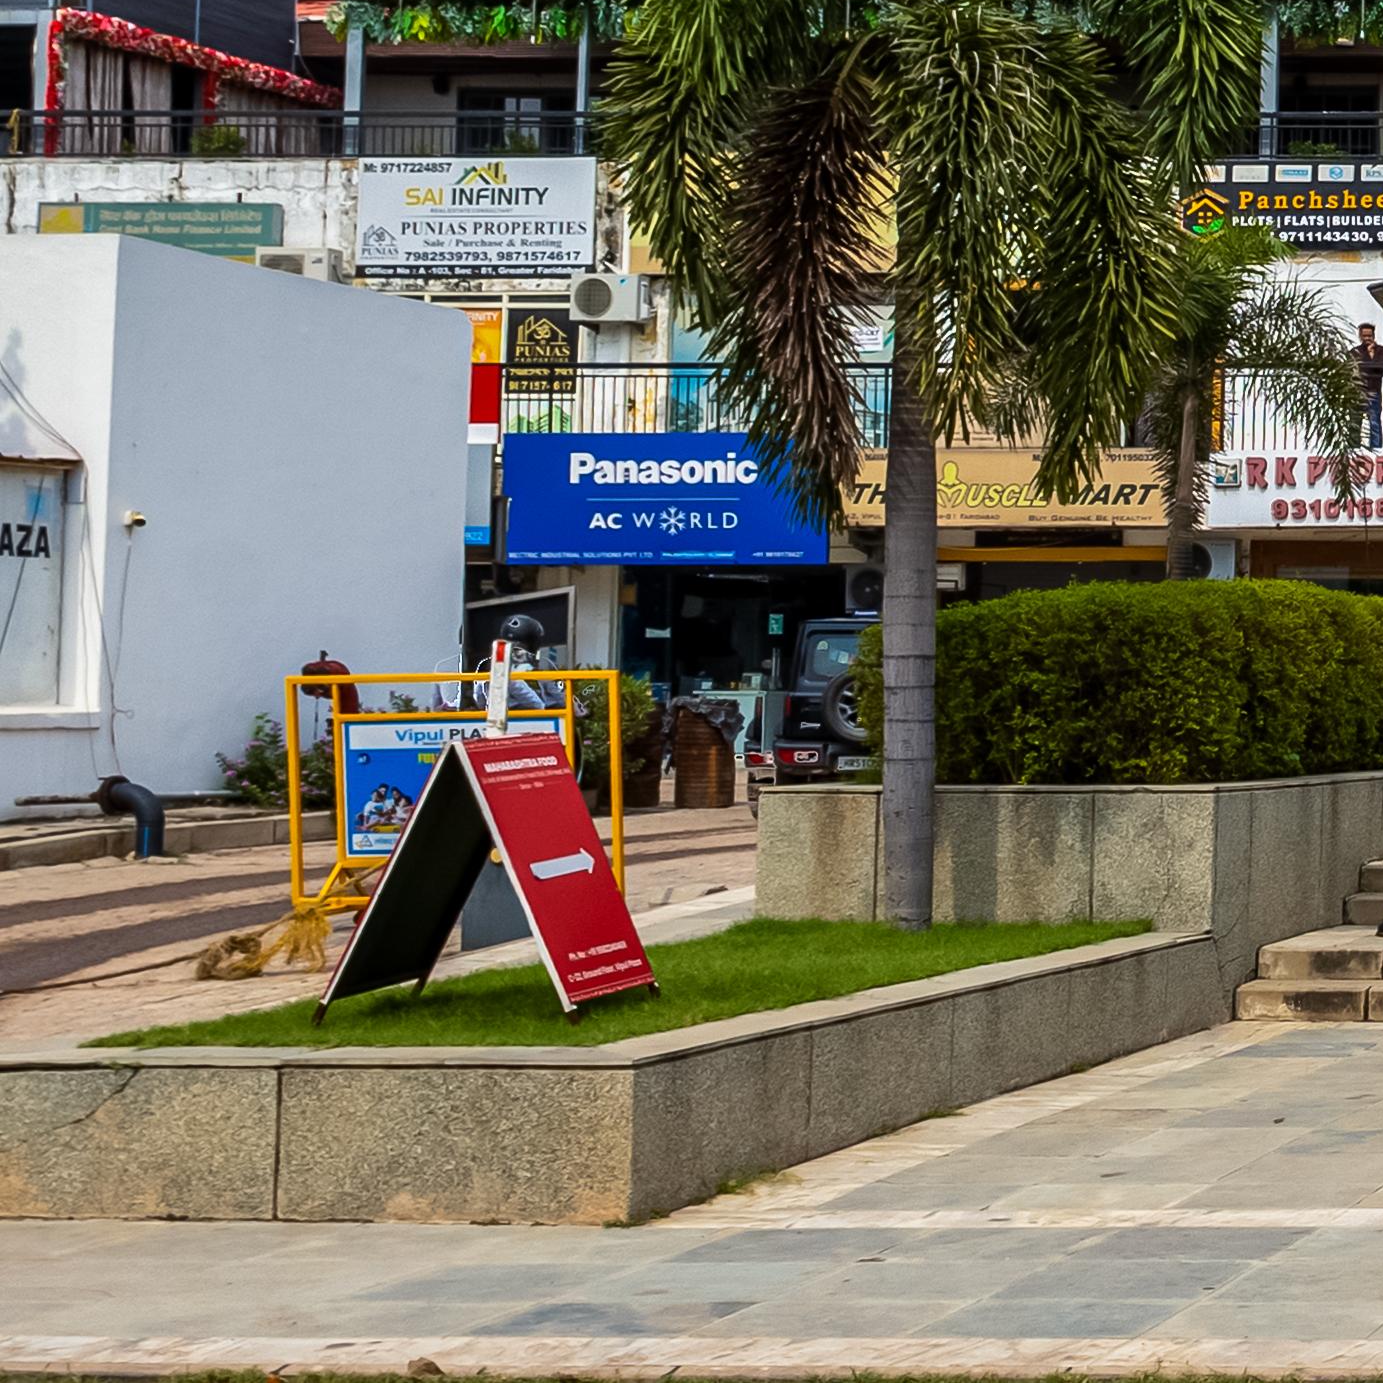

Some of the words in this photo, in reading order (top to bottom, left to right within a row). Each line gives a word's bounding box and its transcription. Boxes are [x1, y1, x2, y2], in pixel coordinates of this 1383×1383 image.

[380, 163, 452, 173] 9717224857
[404, 188, 444, 206] SAI
[451, 187, 549, 206] INFINITY
[1232, 217, 1274, 226] PLOTS
[1284, 216, 1325, 226] FLATS
[401, 221, 467, 235] PUNIAS
[473, 221, 588, 235] PROPERTIES
[423, 239, 445, 247] Sale
[456, 239, 502, 247] Purchase
[520, 239, 563, 248] Renting
[1279, 231, 1373, 243] 9711143430,
[361, 248, 399, 256] PUNIAS
[404, 251, 492, 263] 7982539793,
[497, 251, 581, 262] 9871574617
[515, 346, 570, 356] PUNIAS
[569, 453, 759, 484] Panasonic
[1246, 457, 1268, 488] R
[1275, 457, 1297, 485] K
[853, 483, 885, 504] TH
[589, 513, 622, 529] AC
[395, 728, 444, 744] Vipul
[450, 729, 486, 739] PLA
